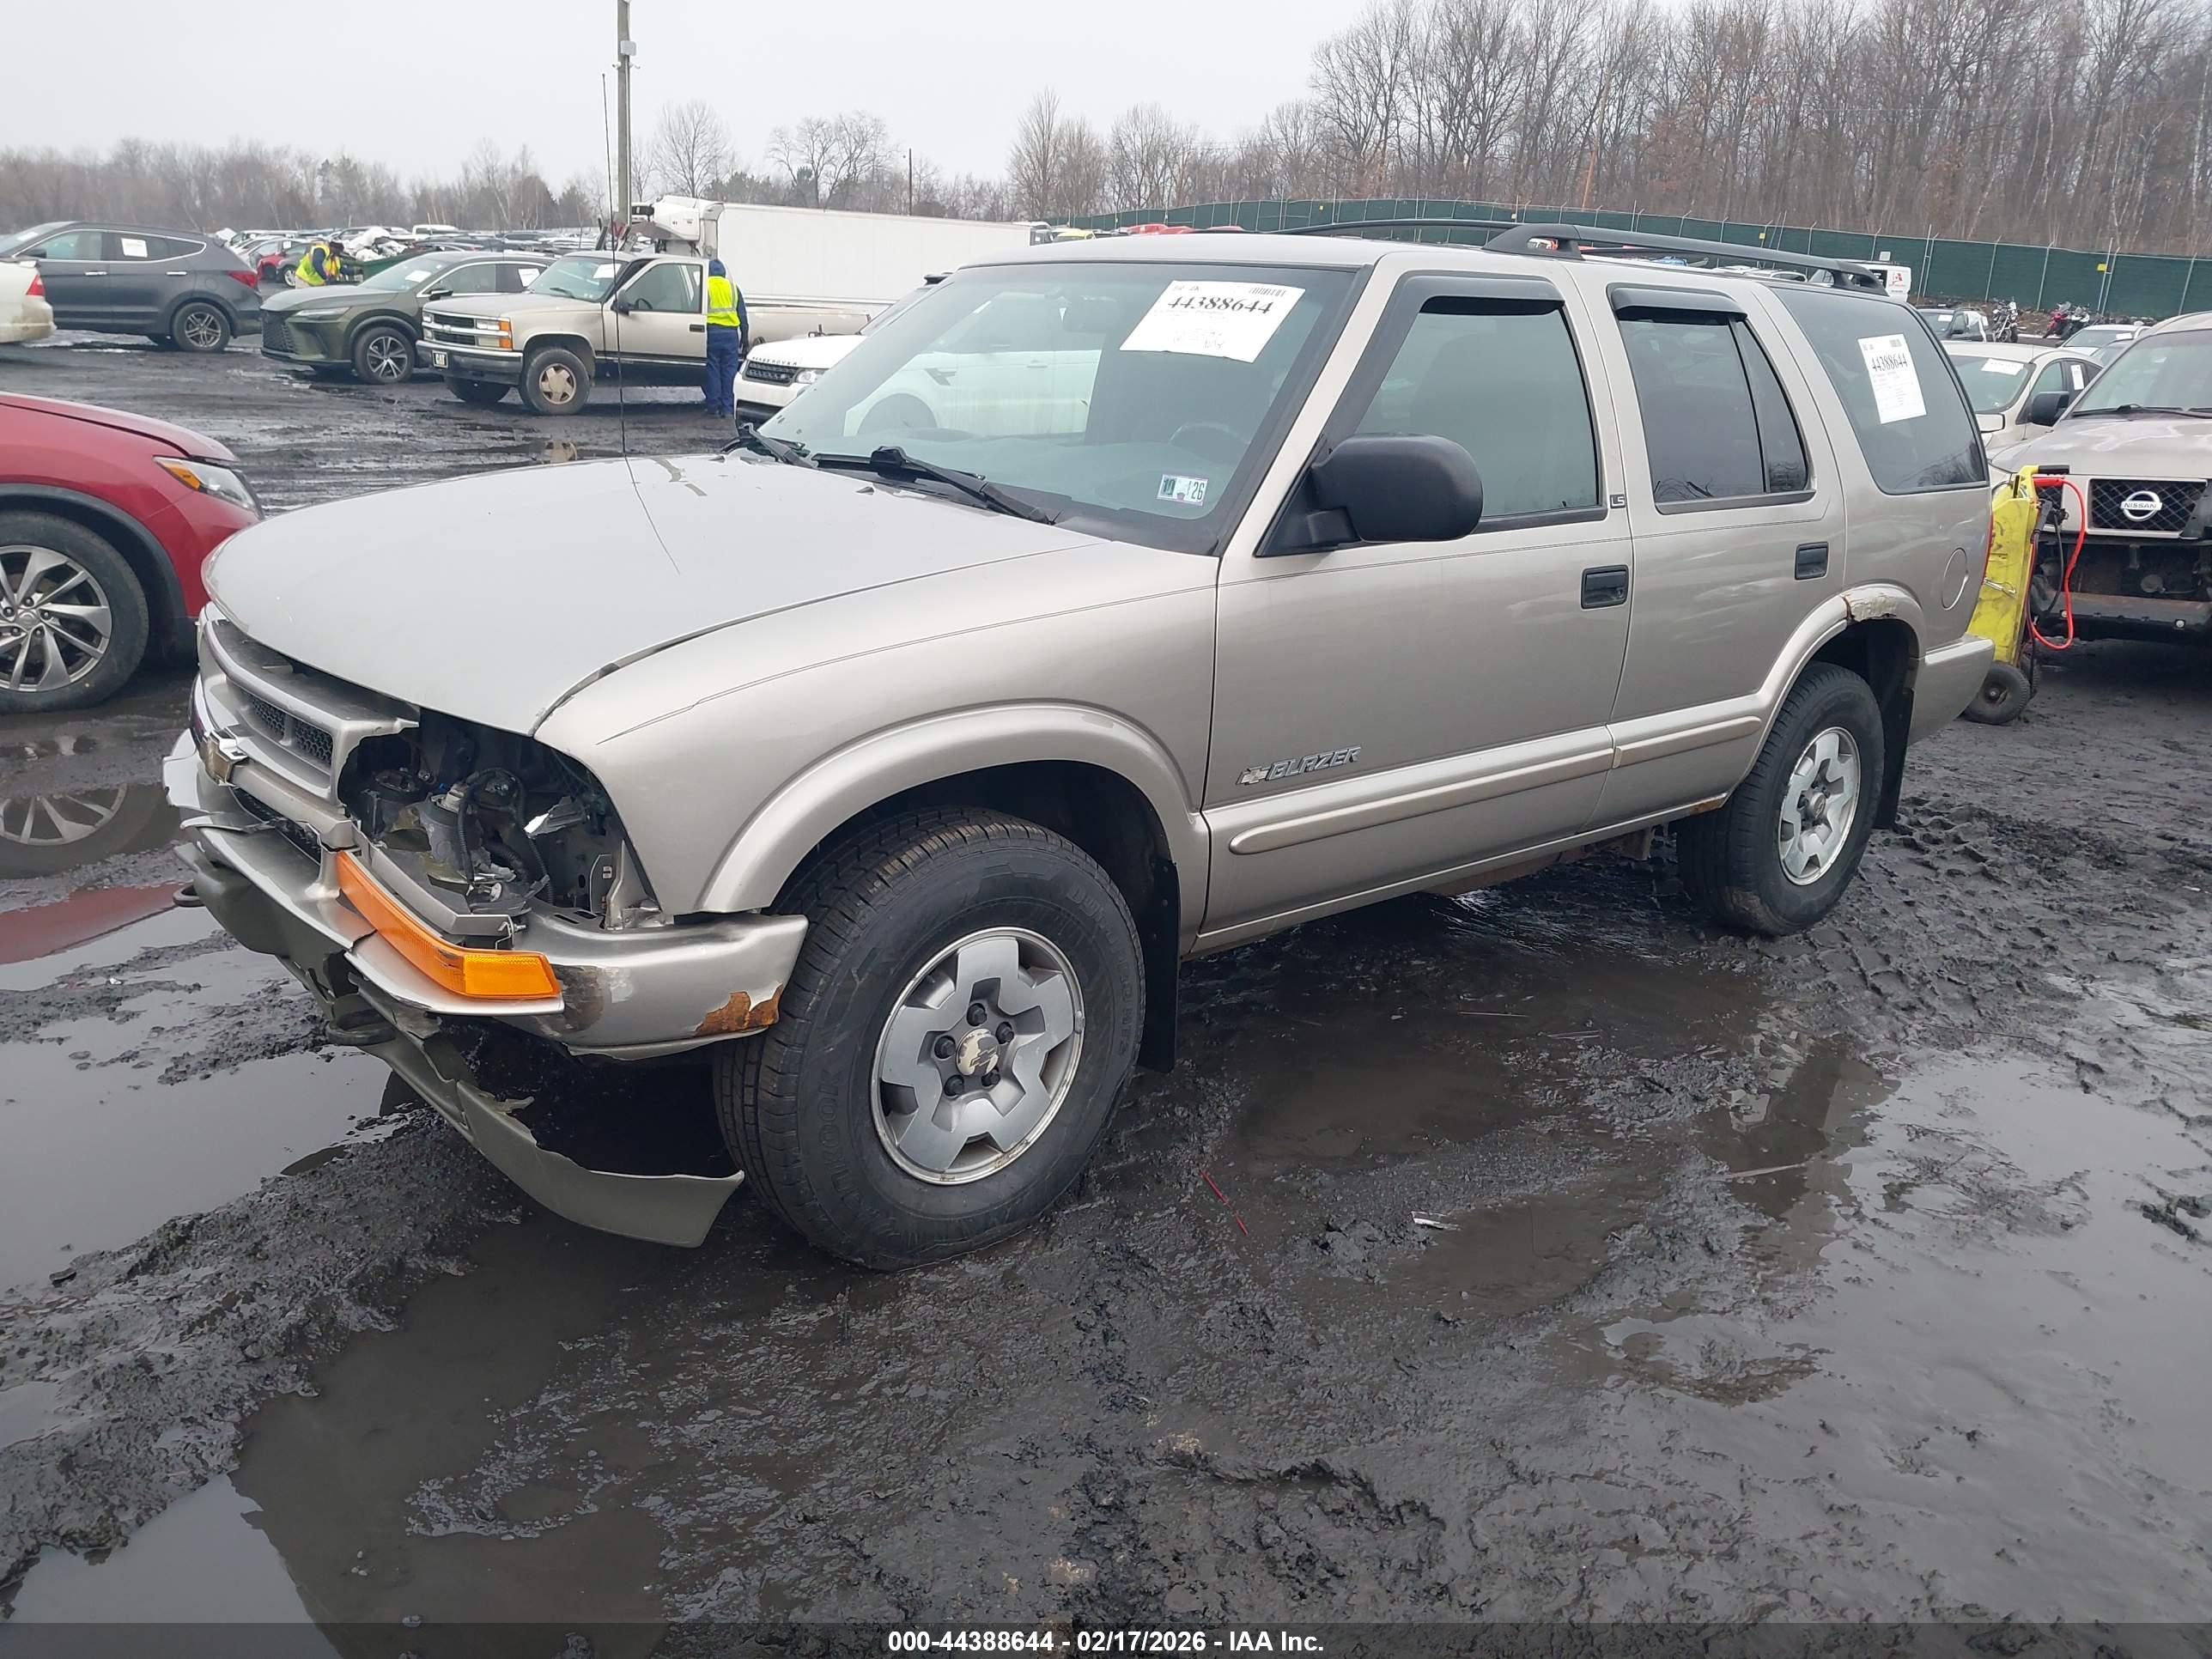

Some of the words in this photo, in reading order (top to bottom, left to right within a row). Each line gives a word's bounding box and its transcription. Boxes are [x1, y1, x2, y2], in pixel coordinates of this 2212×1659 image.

[1168, 295, 1274, 314] 44388644
[1871, 352, 1908, 372] 44388644
[1611, 495, 1625, 507] LS
[1267, 744, 1361, 780] BLAZER
